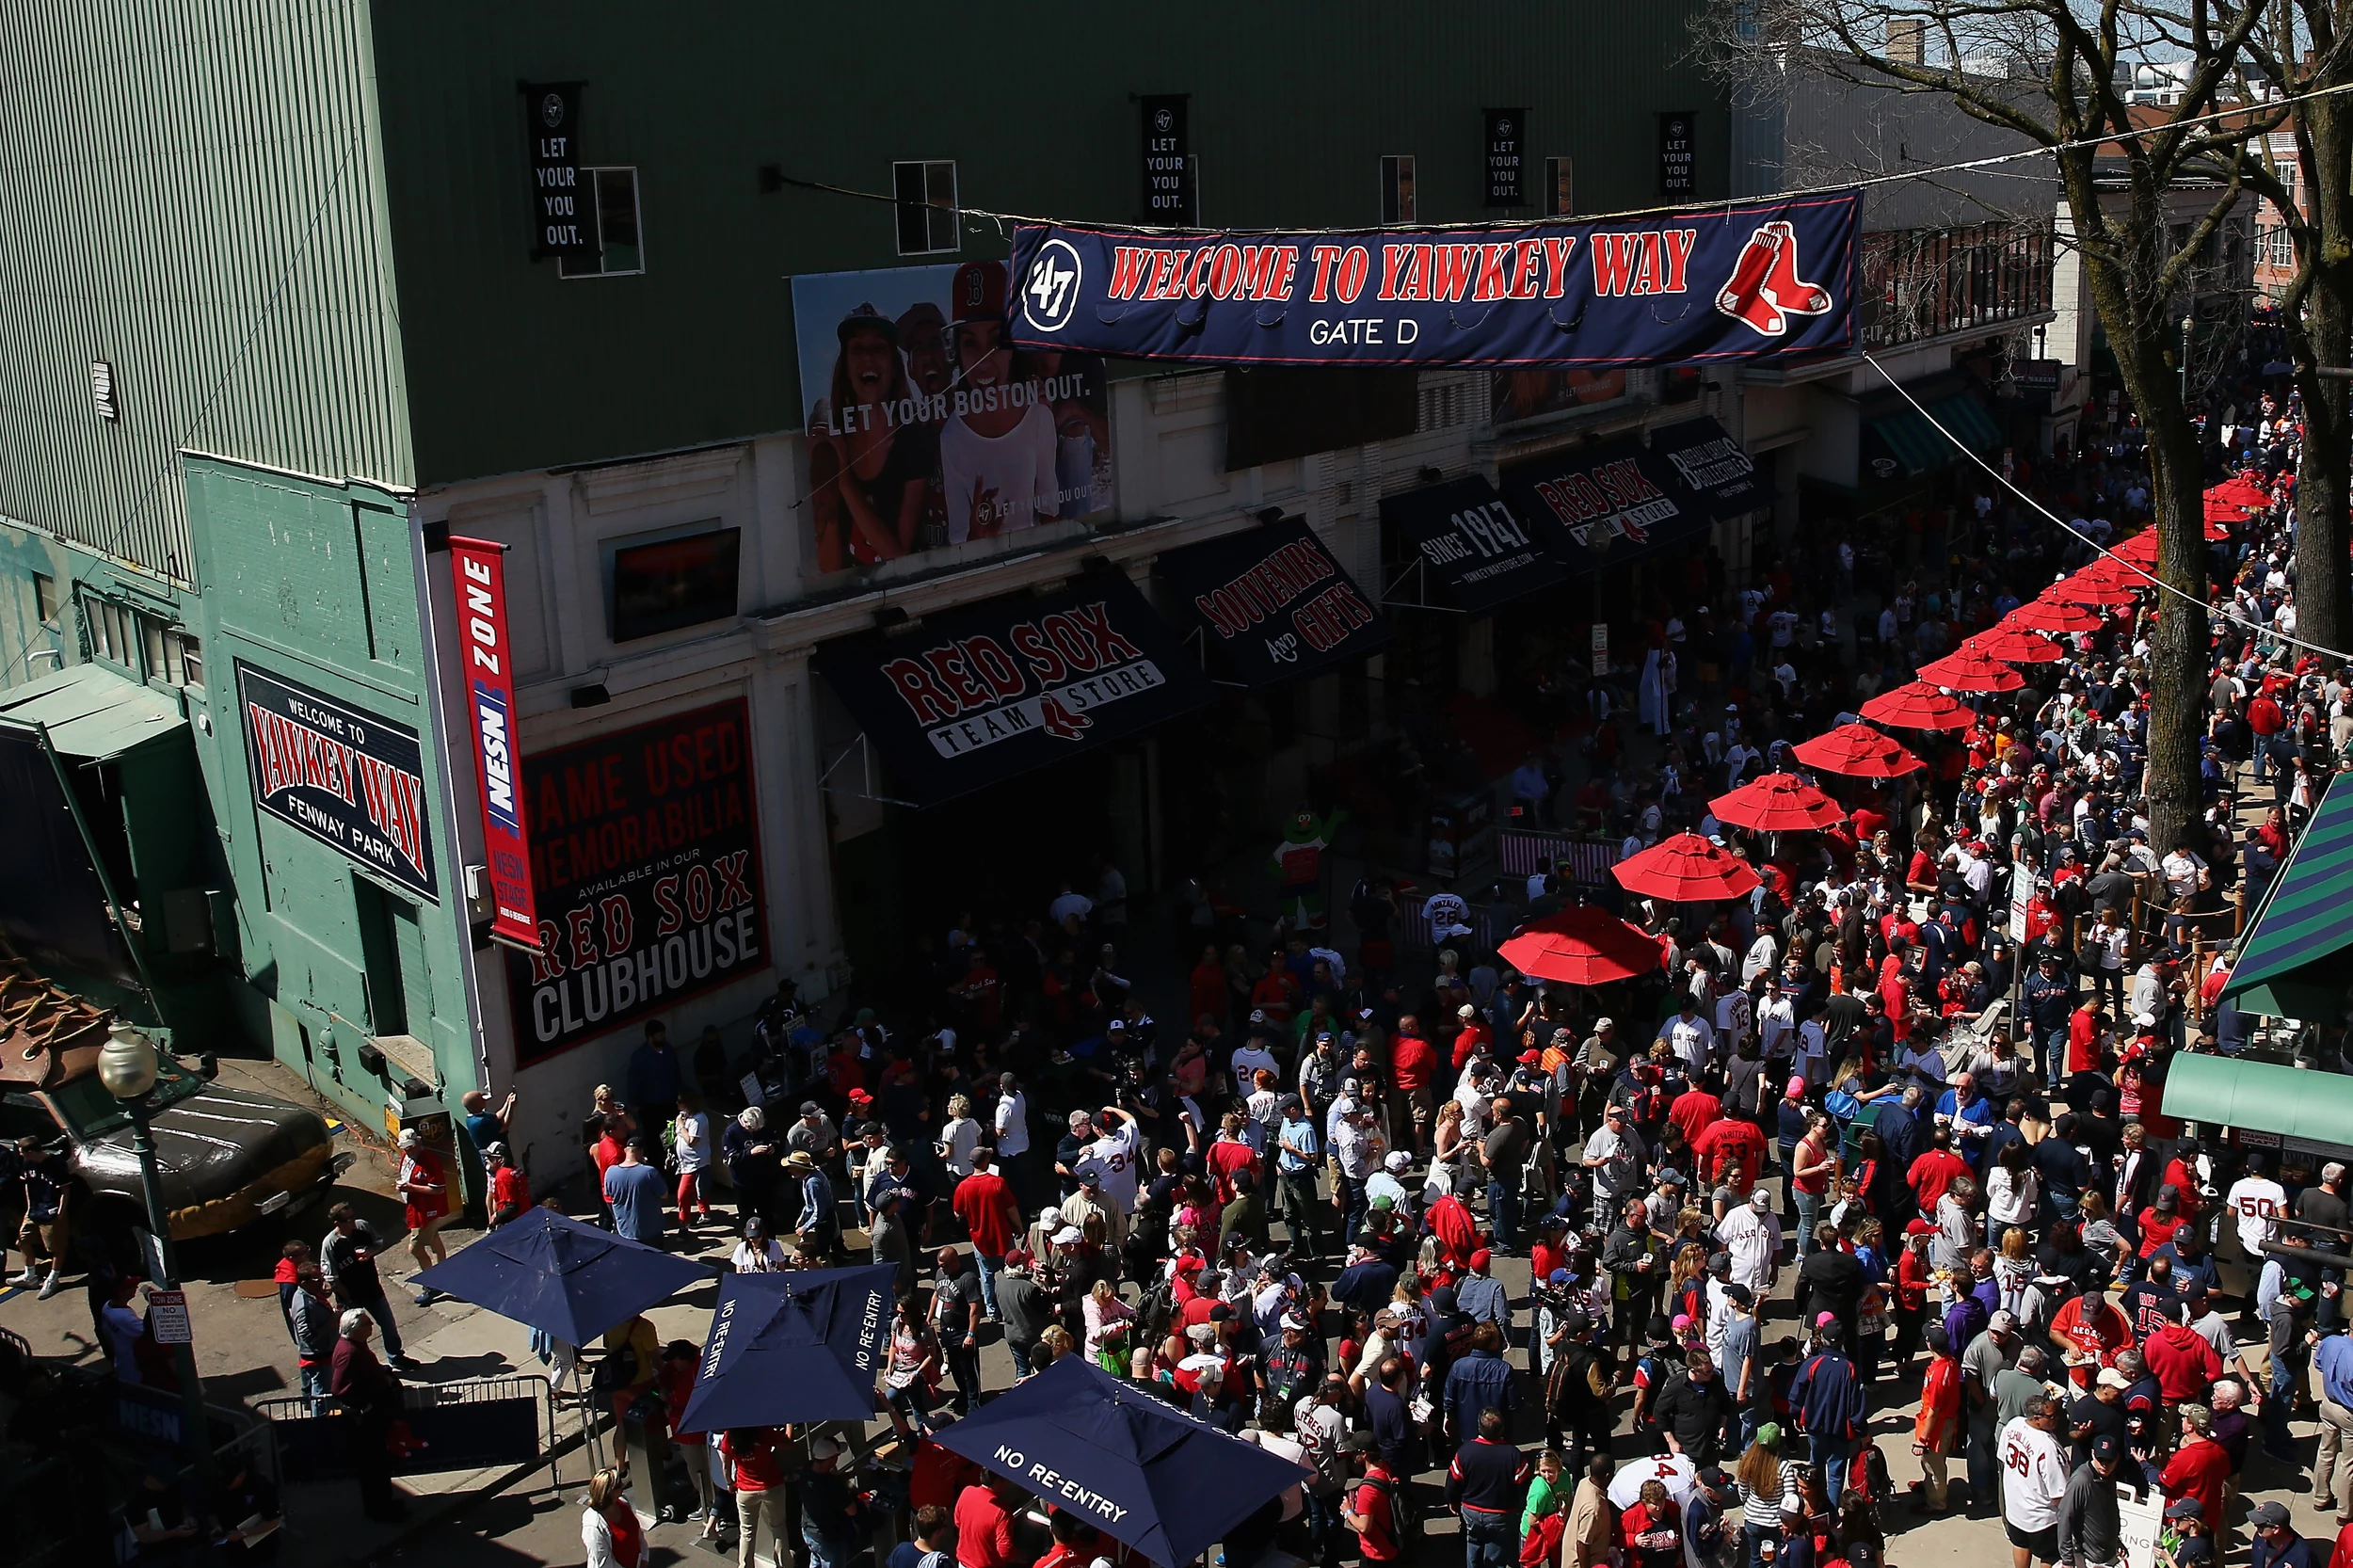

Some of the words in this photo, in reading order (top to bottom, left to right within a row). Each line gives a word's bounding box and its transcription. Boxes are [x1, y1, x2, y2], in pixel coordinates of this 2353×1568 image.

[541, 137, 567, 158] LET
[1151, 138, 1176, 152] LET
[1493, 142, 1514, 152] LET
[1667, 141, 1687, 150] LET
[1146, 156, 1183, 170] YOUR
[1489, 156, 1519, 167] YOUR
[1663, 153, 1691, 162] YOUR
[536, 166, 576, 187] YOUR
[1493, 171, 1515, 181] YOU
[1667, 167, 1688, 175] YOU
[1152, 176, 1178, 189] YOU
[1493, 185, 1518, 197] OUT.
[1666, 179, 1690, 188] OUT.
[544, 196, 574, 216] YOU
[1152, 196, 1183, 209] OUT.
[547, 225, 584, 245] OUT.
[1108, 244, 1300, 303] WELCOME
[1309, 244, 1370, 304] TO
[1377, 235, 1576, 303] YAWKEY
[1590, 229, 1697, 297] WAY
[1309, 319, 1384, 345] GATE
[1396, 319, 1419, 344] D
[828, 404, 872, 437] LET
[881, 393, 949, 425] YOUR
[954, 379, 1037, 417] BOSTON
[1044, 373, 1091, 403] OUT.
[1534, 472, 1611, 528] RED
[1593, 456, 1664, 508] SOX
[994, 502, 1016, 520] LET
[1633, 501, 1674, 525] STORE
[1419, 533, 1473, 567] SINCE
[1450, 500, 1531, 558] 1947
[1461, 552, 1537, 585] YAWKEYWAYSTORE.COM
[1195, 536, 1336, 639] SOUVENIRS
[462, 555, 501, 677] ZONE
[1265, 632, 1298, 664] AND
[1290, 581, 1374, 652] GIFTS
[880, 638, 1027, 728] RED
[1009, 600, 1144, 692] SOX
[936, 705, 1032, 753] TEAM
[1065, 664, 1157, 708] STORE
[288, 697, 344, 736] WELCOME
[347, 723, 366, 744] TO
[477, 702, 517, 814] NESN
[644, 720, 741, 798] USED
[248, 701, 357, 808] YAWKEY
[354, 749, 427, 883] WAY
[288, 792, 345, 840] FENWAY
[351, 827, 397, 867] PARK
[493, 850, 526, 882] NESN
[578, 868, 653, 900] AVAILABLE
[657, 858, 670, 873] IN
[674, 848, 701, 867] OUR
[497, 880, 529, 910] STAGE
[527, 893, 634, 986] RED
[653, 849, 754, 936] SOX
[1434, 911, 1457, 925] 28
[533, 906, 760, 1043] CLUBHOUSE
[969, 982, 984, 991] Red
[1736, 1009, 1749, 1030] 13
[2241, 1132, 2278, 1142] SEASONAL
[2241, 1137, 2278, 1146] CRAFT
[1721, 1143, 1747, 1160] 33
[1111, 1152, 1134, 1174] 34
[2240, 1197, 2272, 1218] 50
[1739, 1229, 1755, 1240] RED
[339, 1256, 354, 1269] RED
[2006, 1274, 2027, 1291] 15
[721, 1299, 736, 1319] NO
[858, 1289, 883, 1349] RE-ENTRY
[1401, 1308, 1425, 1319] ORTIZ
[1401, 1319, 1427, 1341] 34
[2137, 1307, 2165, 1333] 15
[2073, 1326, 2089, 1335] RED
[2090, 1330, 2107, 1343] SOX
[702, 1320, 731, 1380] RE-ENTRY
[855, 1350, 871, 1371] NO
[118, 1400, 181, 1443] NESN
[2006, 1443, 2028, 1487] 38
[994, 1445, 1025, 1469] NO
[1027, 1463, 1128, 1524] RE-ENTRY
